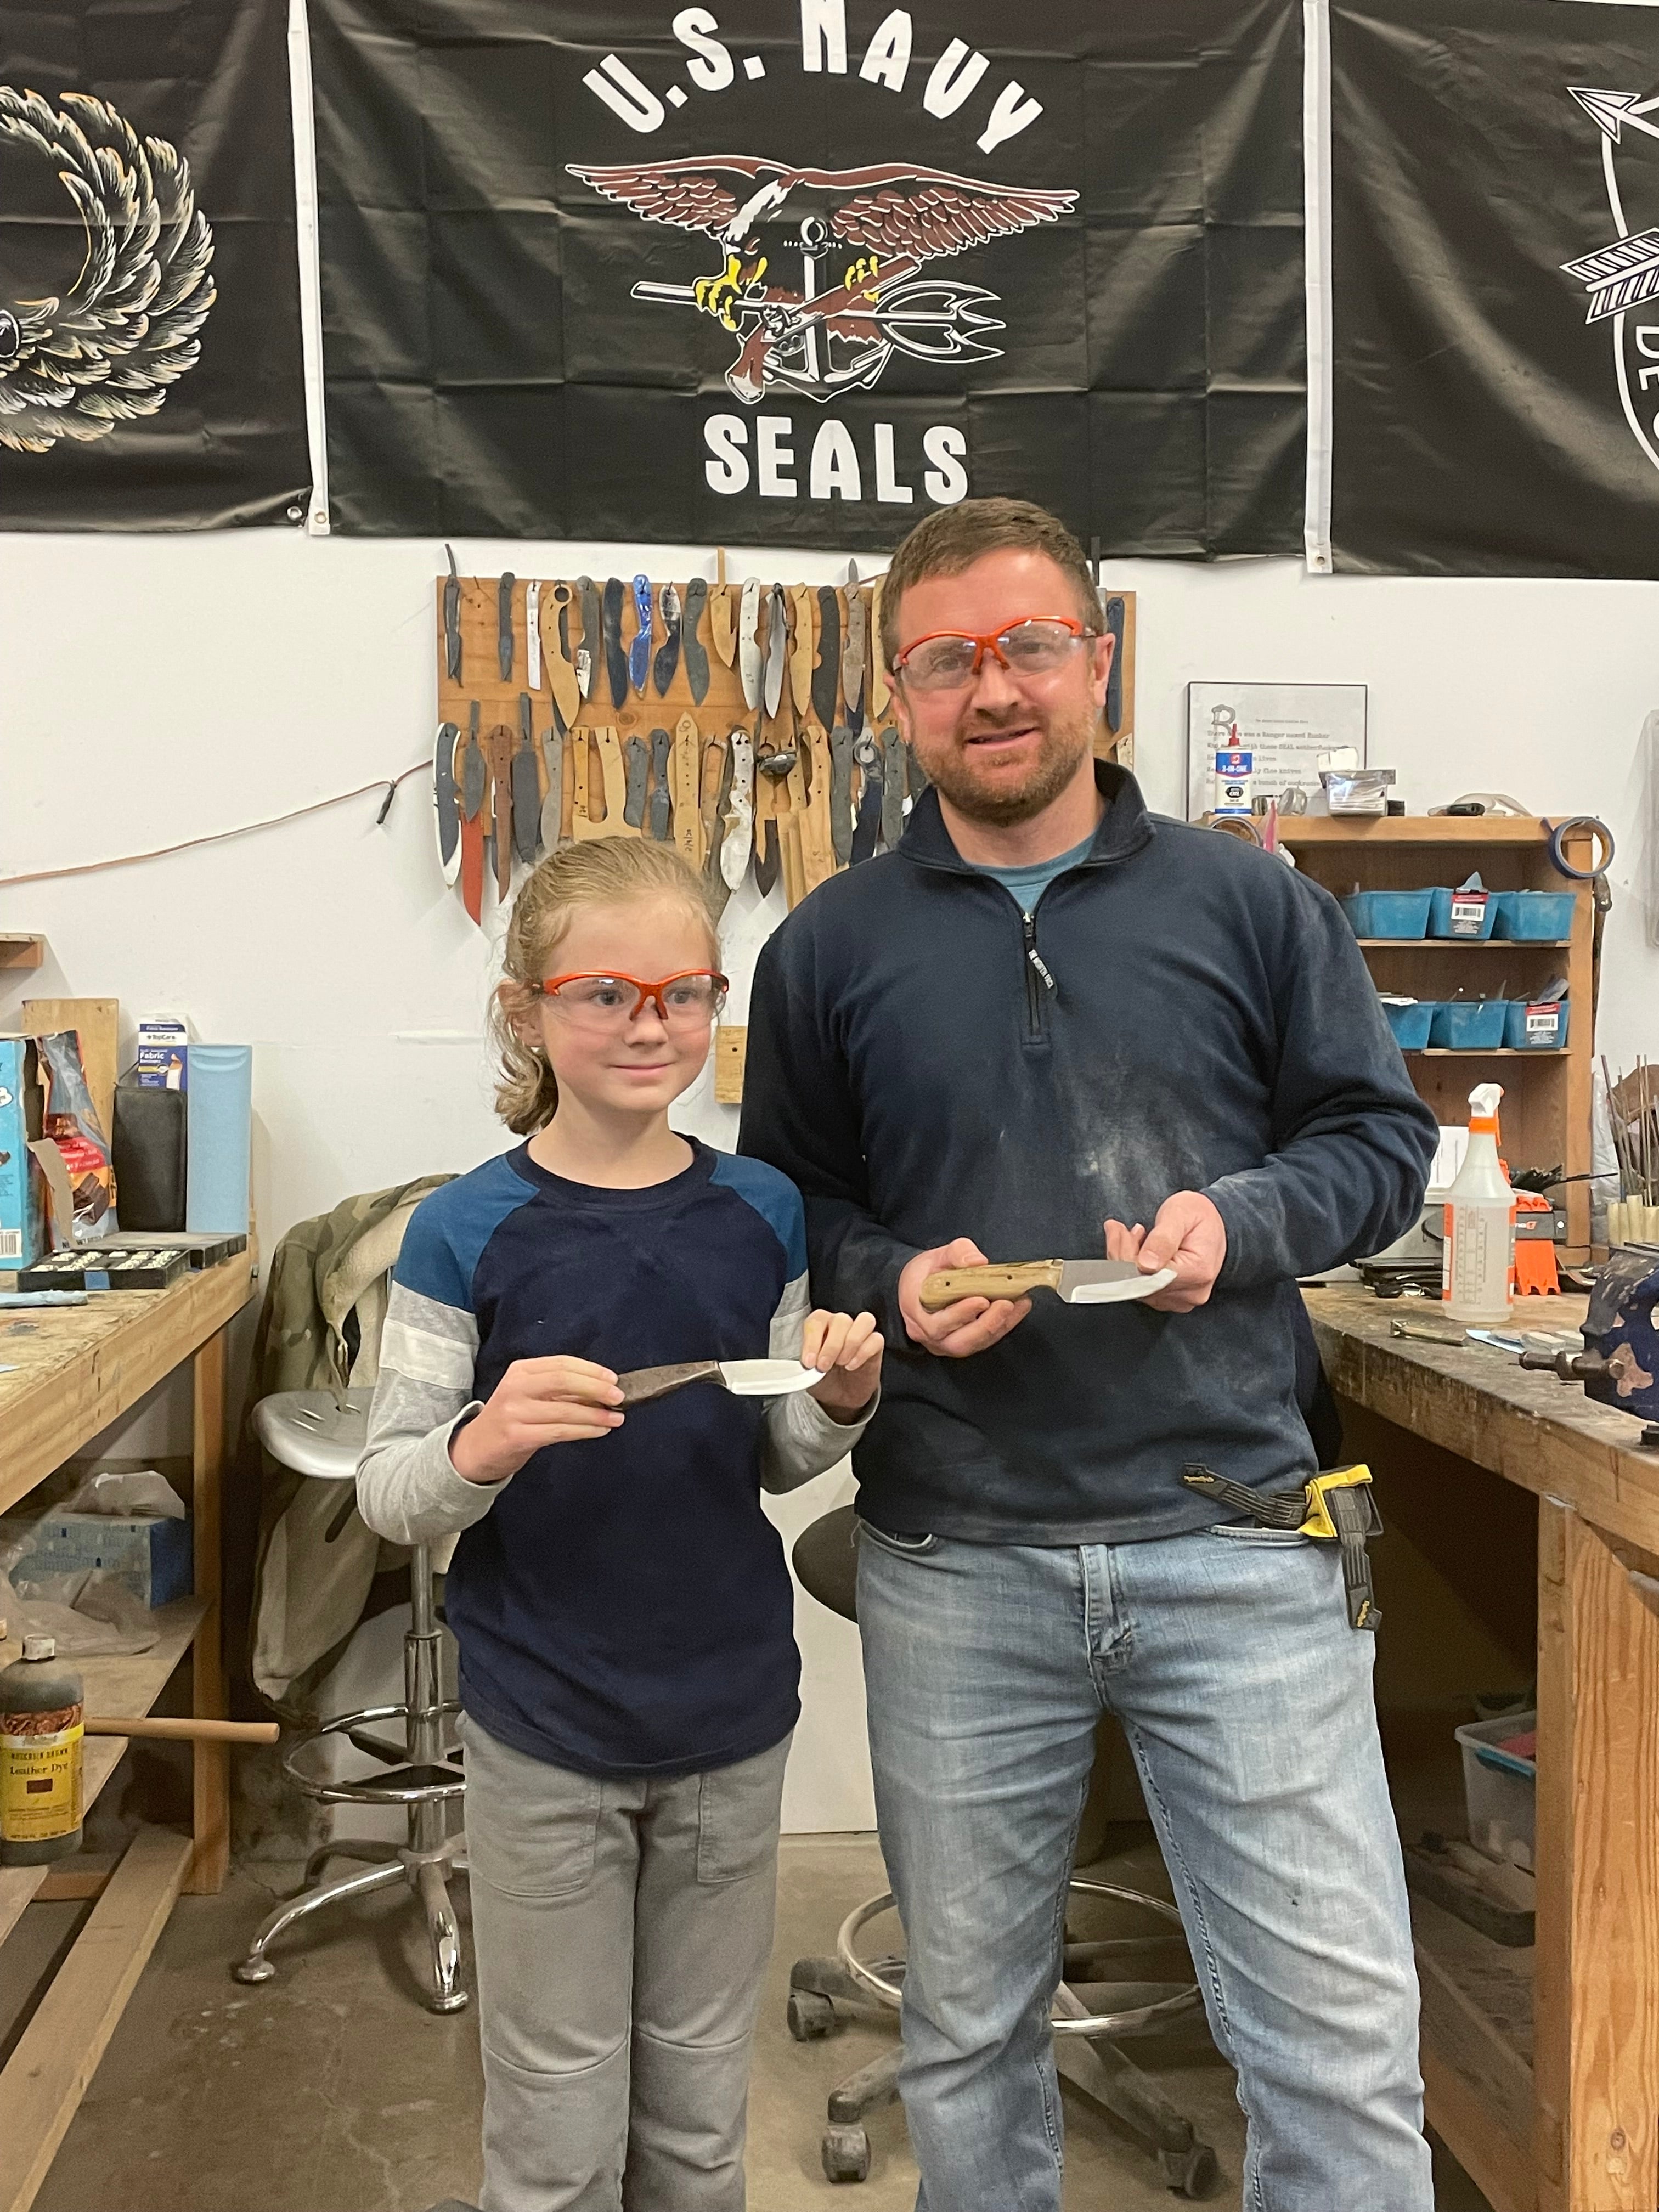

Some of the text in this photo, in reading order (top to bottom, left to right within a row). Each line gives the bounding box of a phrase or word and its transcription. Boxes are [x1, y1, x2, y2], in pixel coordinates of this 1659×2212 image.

[582, 0, 1043, 154] U.S. NAVY
[703, 414, 968, 505] SEALS
[10, 1762, 69, 1775] Leather Dye
